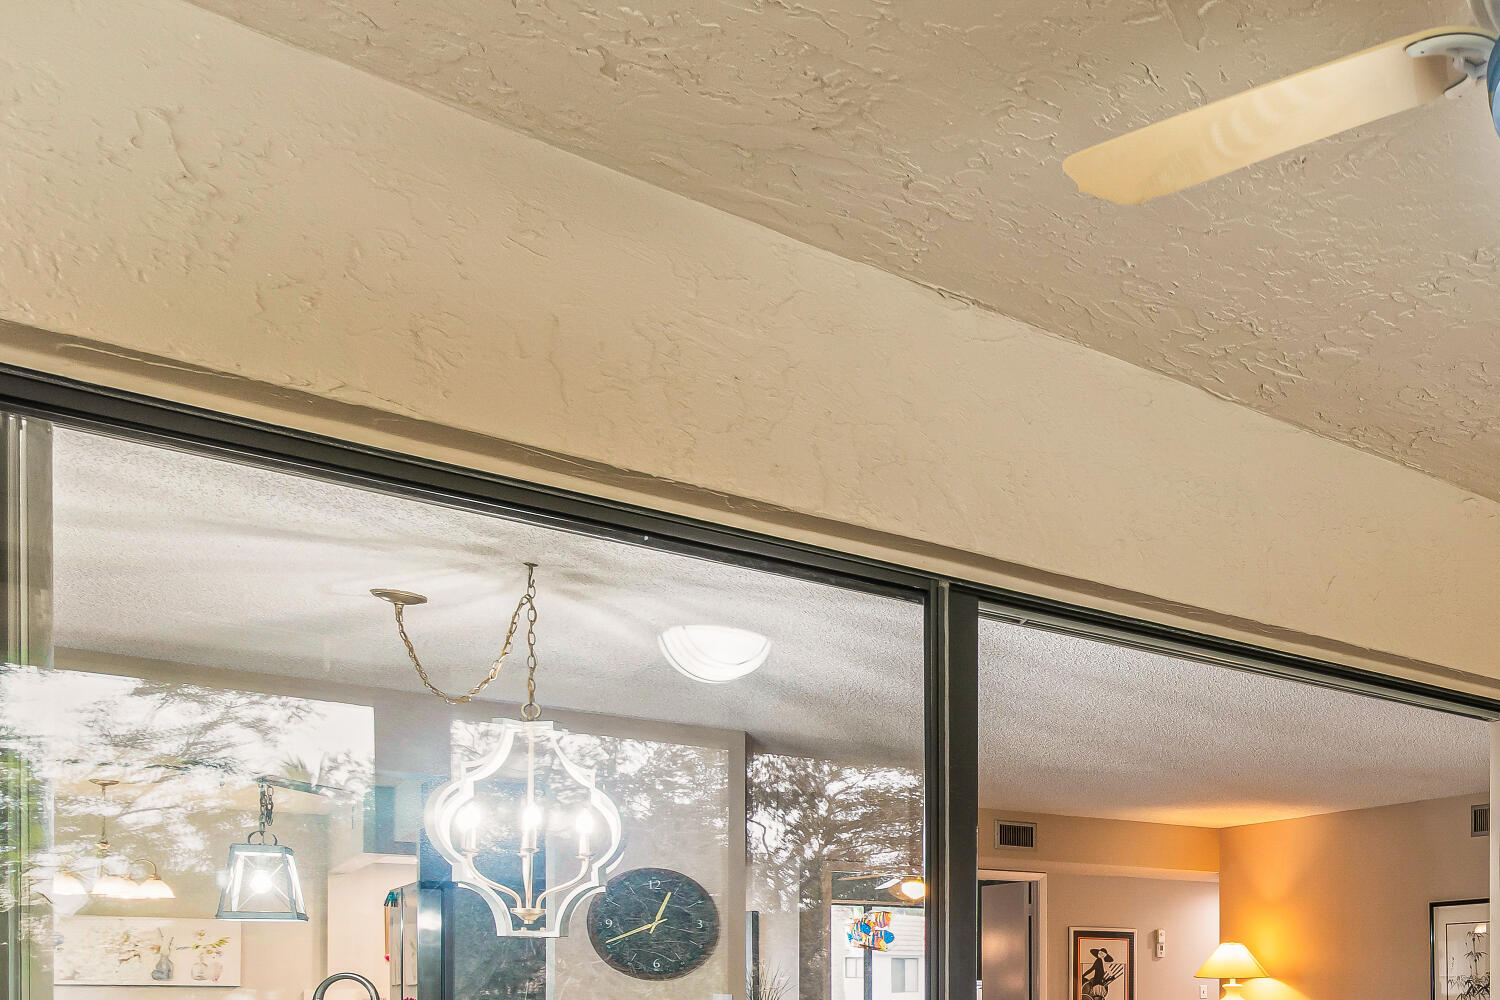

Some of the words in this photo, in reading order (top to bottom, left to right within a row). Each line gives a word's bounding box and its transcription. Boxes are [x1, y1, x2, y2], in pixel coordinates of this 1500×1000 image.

[648, 880, 661, 890] 12
[605, 919, 612, 928] 9
[696, 919, 703, 928] 3
[652, 958, 660, 968] 6
